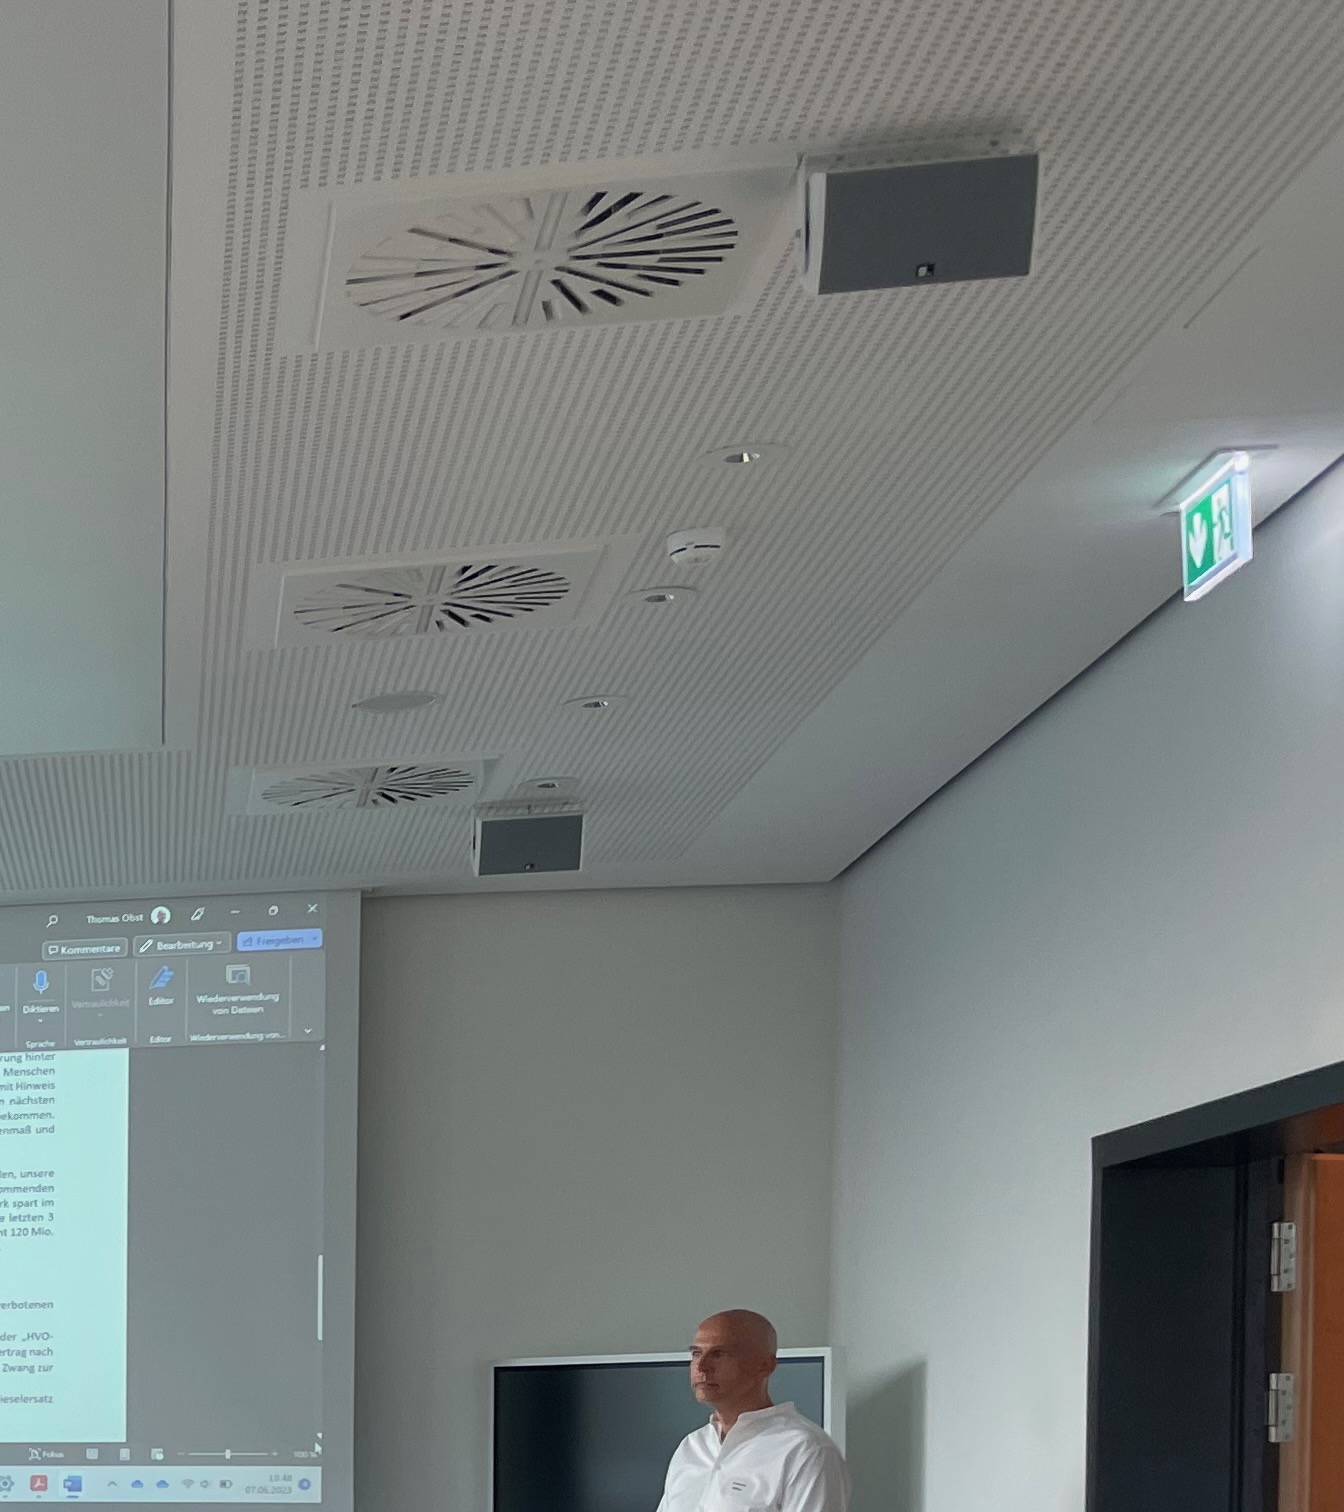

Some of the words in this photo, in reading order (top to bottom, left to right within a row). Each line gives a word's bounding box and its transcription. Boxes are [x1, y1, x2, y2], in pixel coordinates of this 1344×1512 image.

[60, 944, 121, 955] Kommentare
[157, 939, 214, 952] Bearbeitung
[3, 1068, 56, 1079] Menschen
[9, 1097, 55, 1108] nächsten
[35, 1126, 55, 1136] und
[9, 1213, 44, 1224] letzten
